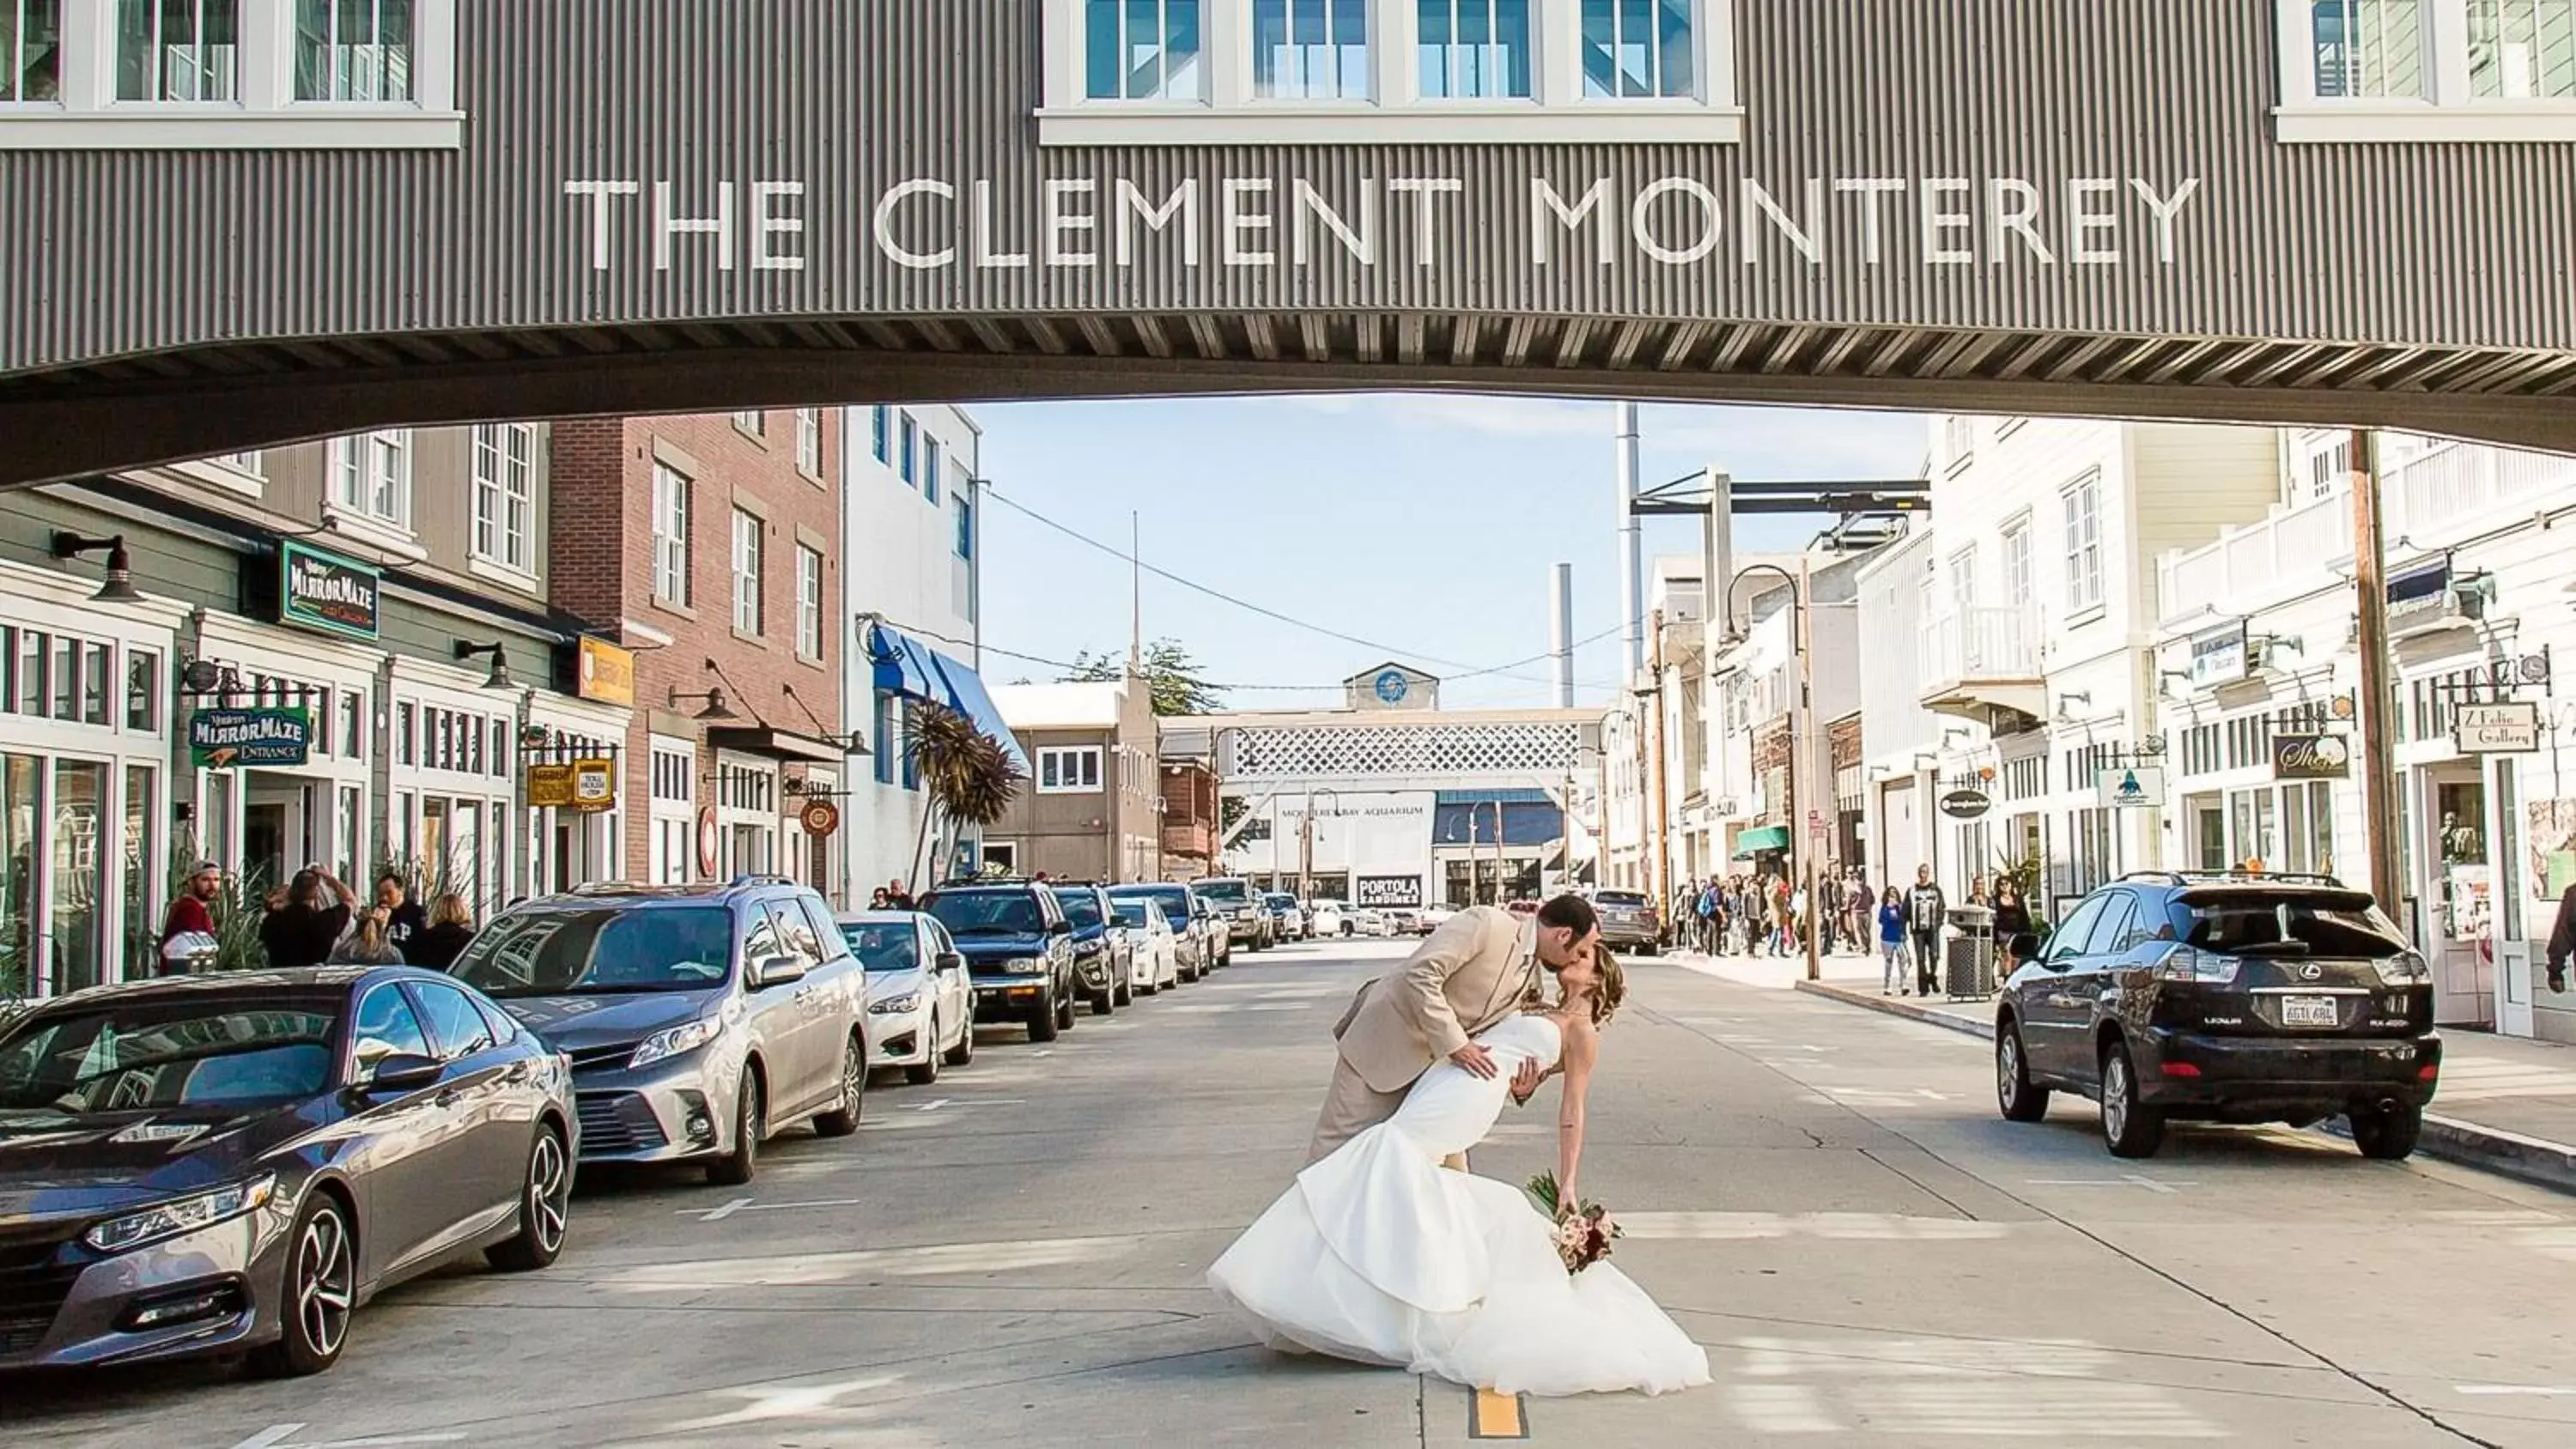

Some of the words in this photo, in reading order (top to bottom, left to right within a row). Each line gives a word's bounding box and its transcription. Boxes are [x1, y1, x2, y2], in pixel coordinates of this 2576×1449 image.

[564, 180, 805, 270] THE
[873, 177, 1462, 269] CLEMENT
[1531, 175, 2201, 265] MONTEREY
[2478, 727, 2530, 745] Gallery
[1364, 806, 1424, 816] AQUARIUM
[1359, 879, 1419, 896] PORTOLA
